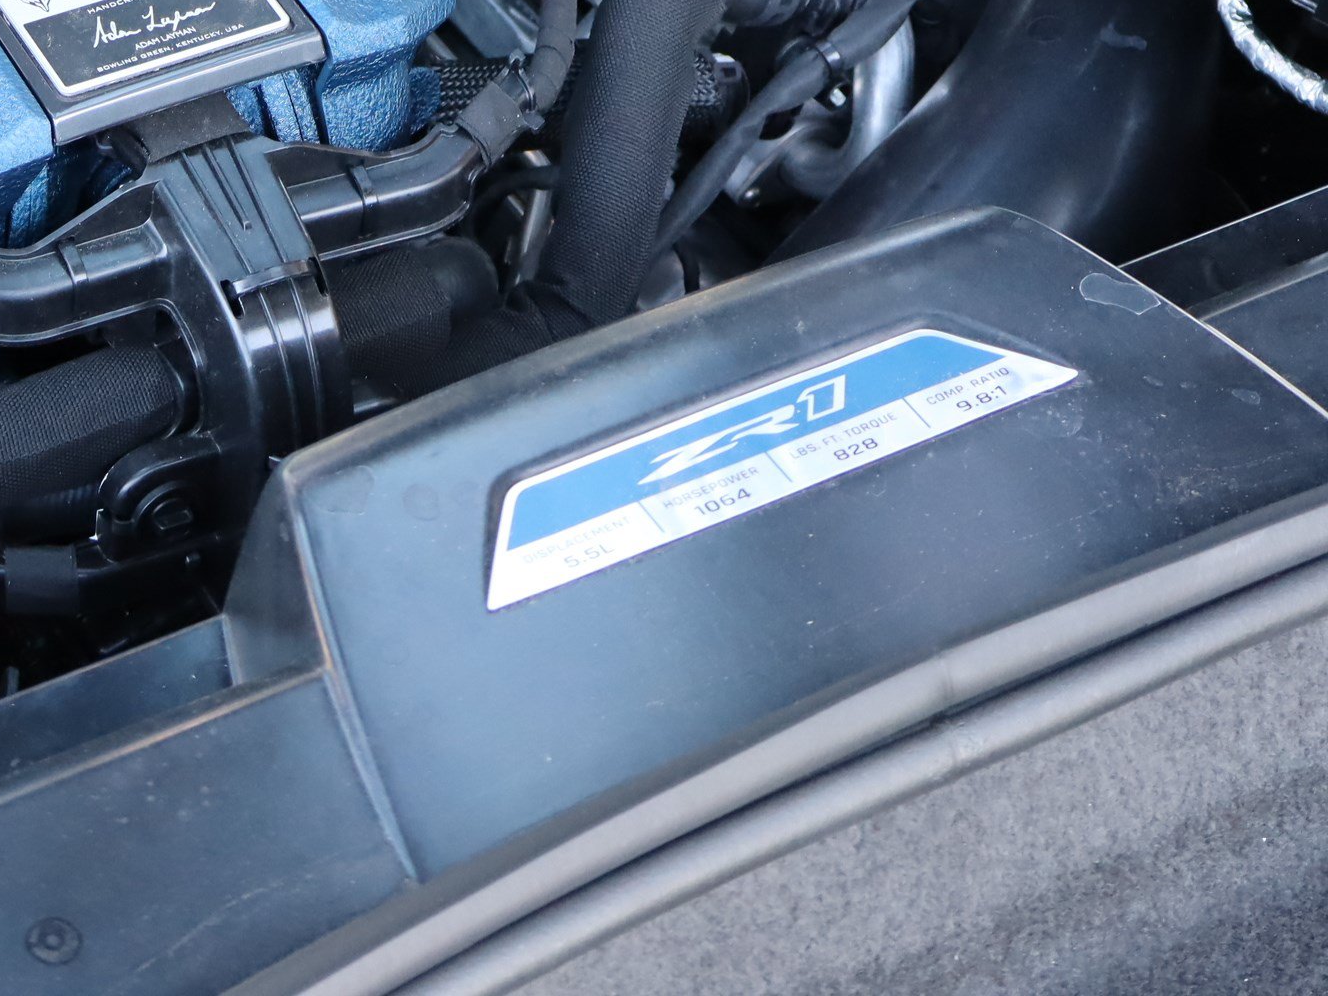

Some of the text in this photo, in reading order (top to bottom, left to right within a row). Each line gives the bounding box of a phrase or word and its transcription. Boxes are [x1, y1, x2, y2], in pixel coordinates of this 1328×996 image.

[97, 23, 245, 73] BOWLING GREEN, KENTUCKY, USA
[135, 26, 196, 50] ADAM LAYMAN
[970, 367, 1009, 387] RATIO
[956, 385, 1007, 412] 9.8:1
[637, 373, 847, 485] ZR1
[844, 412, 897, 437] TORQUE
[833, 437, 878, 460] 828
[662, 466, 761, 509] HORSEPOWER
[694, 486, 752, 518] 1064
[522, 516, 632, 565] DISPLACEMENT
[564, 544, 615, 569] 5.5L
